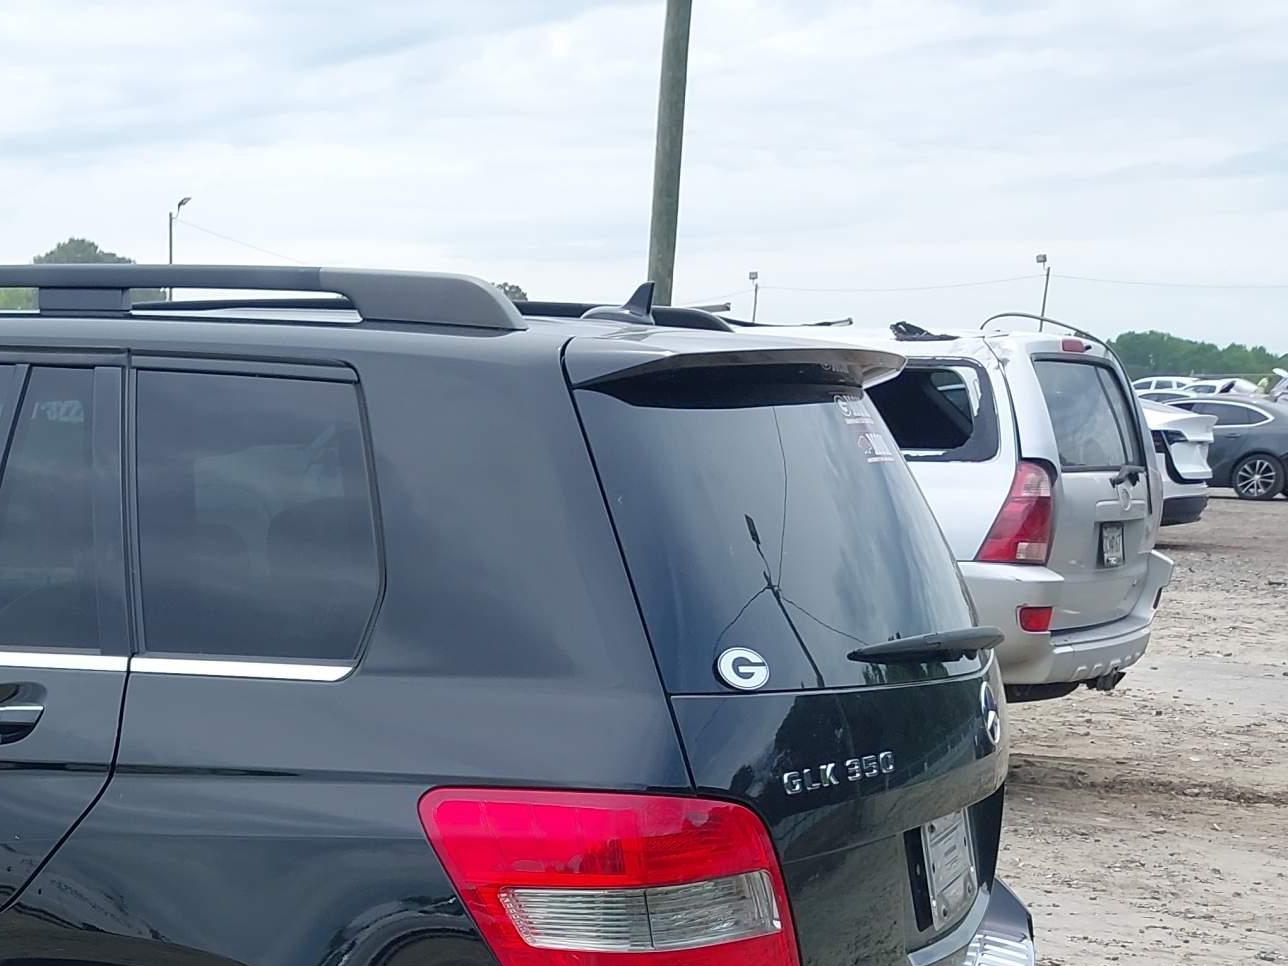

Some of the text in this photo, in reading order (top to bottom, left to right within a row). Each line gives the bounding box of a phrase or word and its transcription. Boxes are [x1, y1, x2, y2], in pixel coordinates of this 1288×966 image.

[717, 646, 770, 690] G
[783, 751, 895, 795] GLK 350
